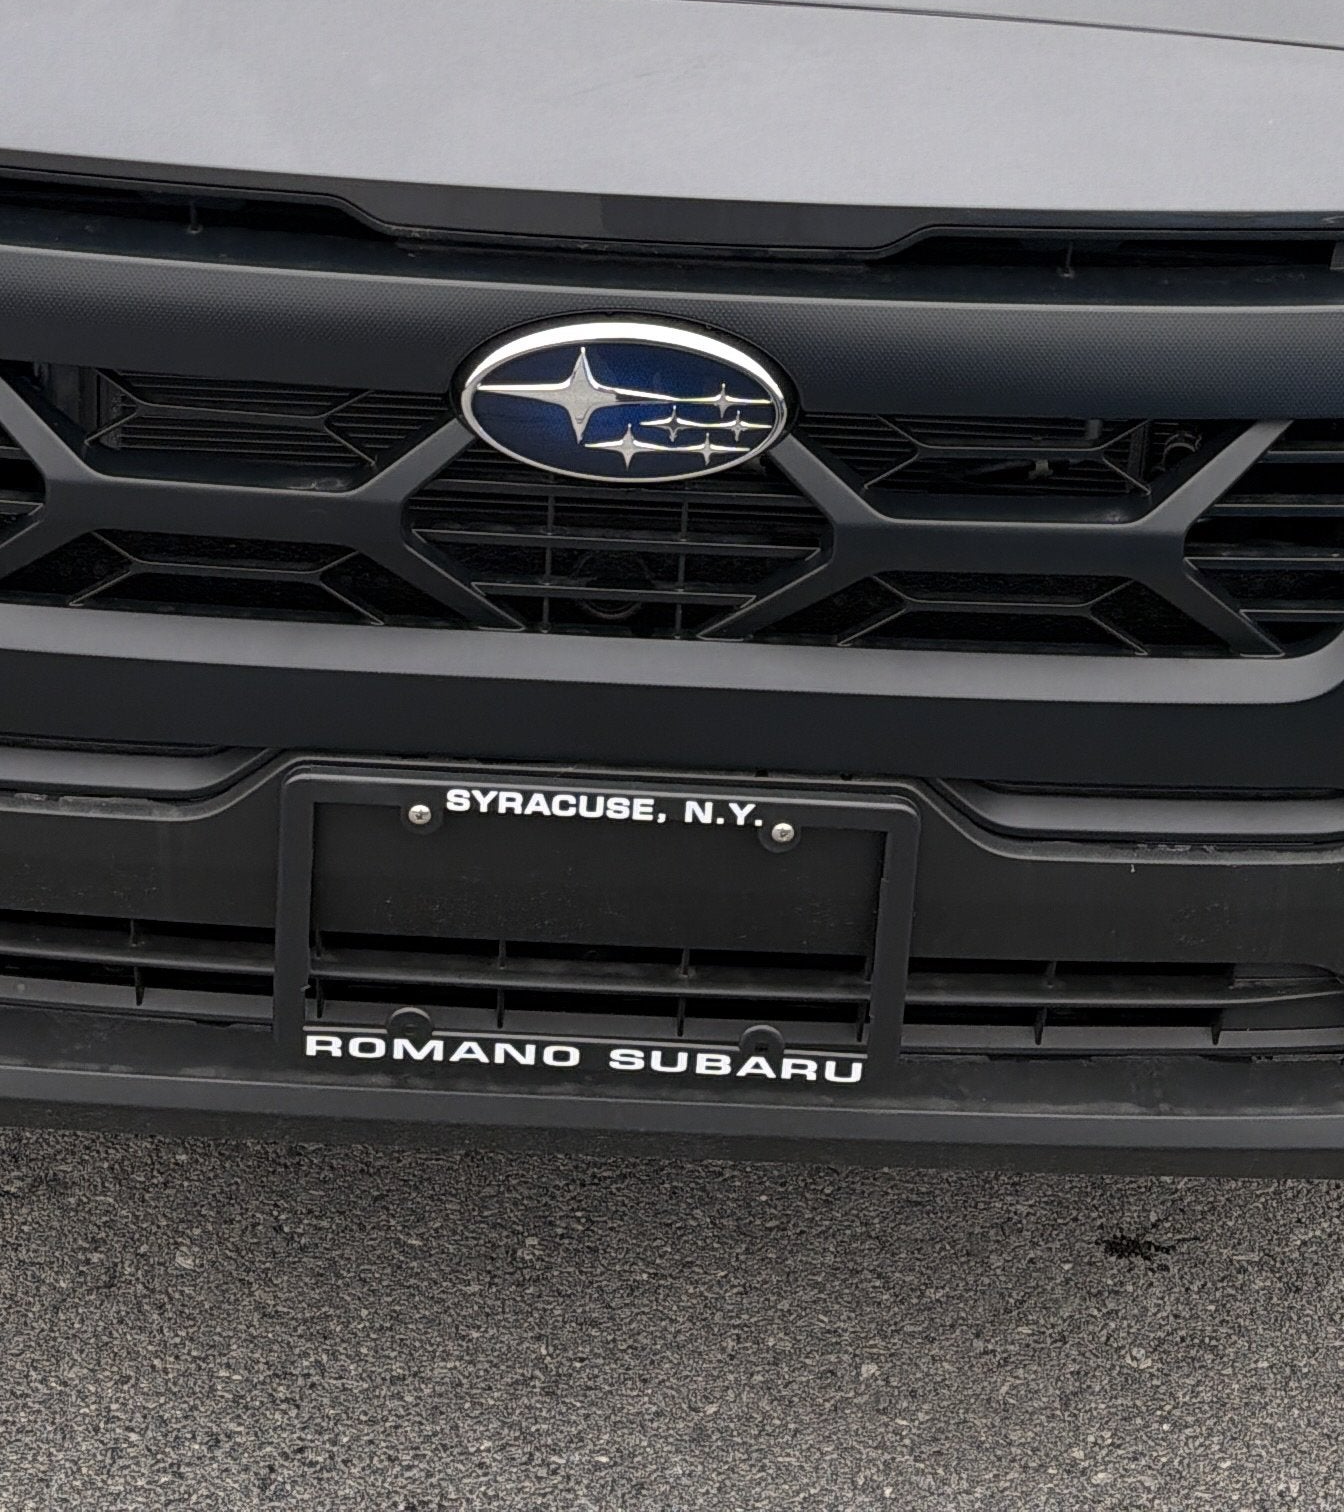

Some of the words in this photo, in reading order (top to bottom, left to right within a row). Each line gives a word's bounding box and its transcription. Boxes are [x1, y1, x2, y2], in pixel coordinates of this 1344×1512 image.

[447, 789, 665, 822] SYRACUSE,
[685, 801, 762, 826] N.Y.
[306, 1036, 579, 1066] ROMANO
[610, 1049, 862, 1082] SUBARU
